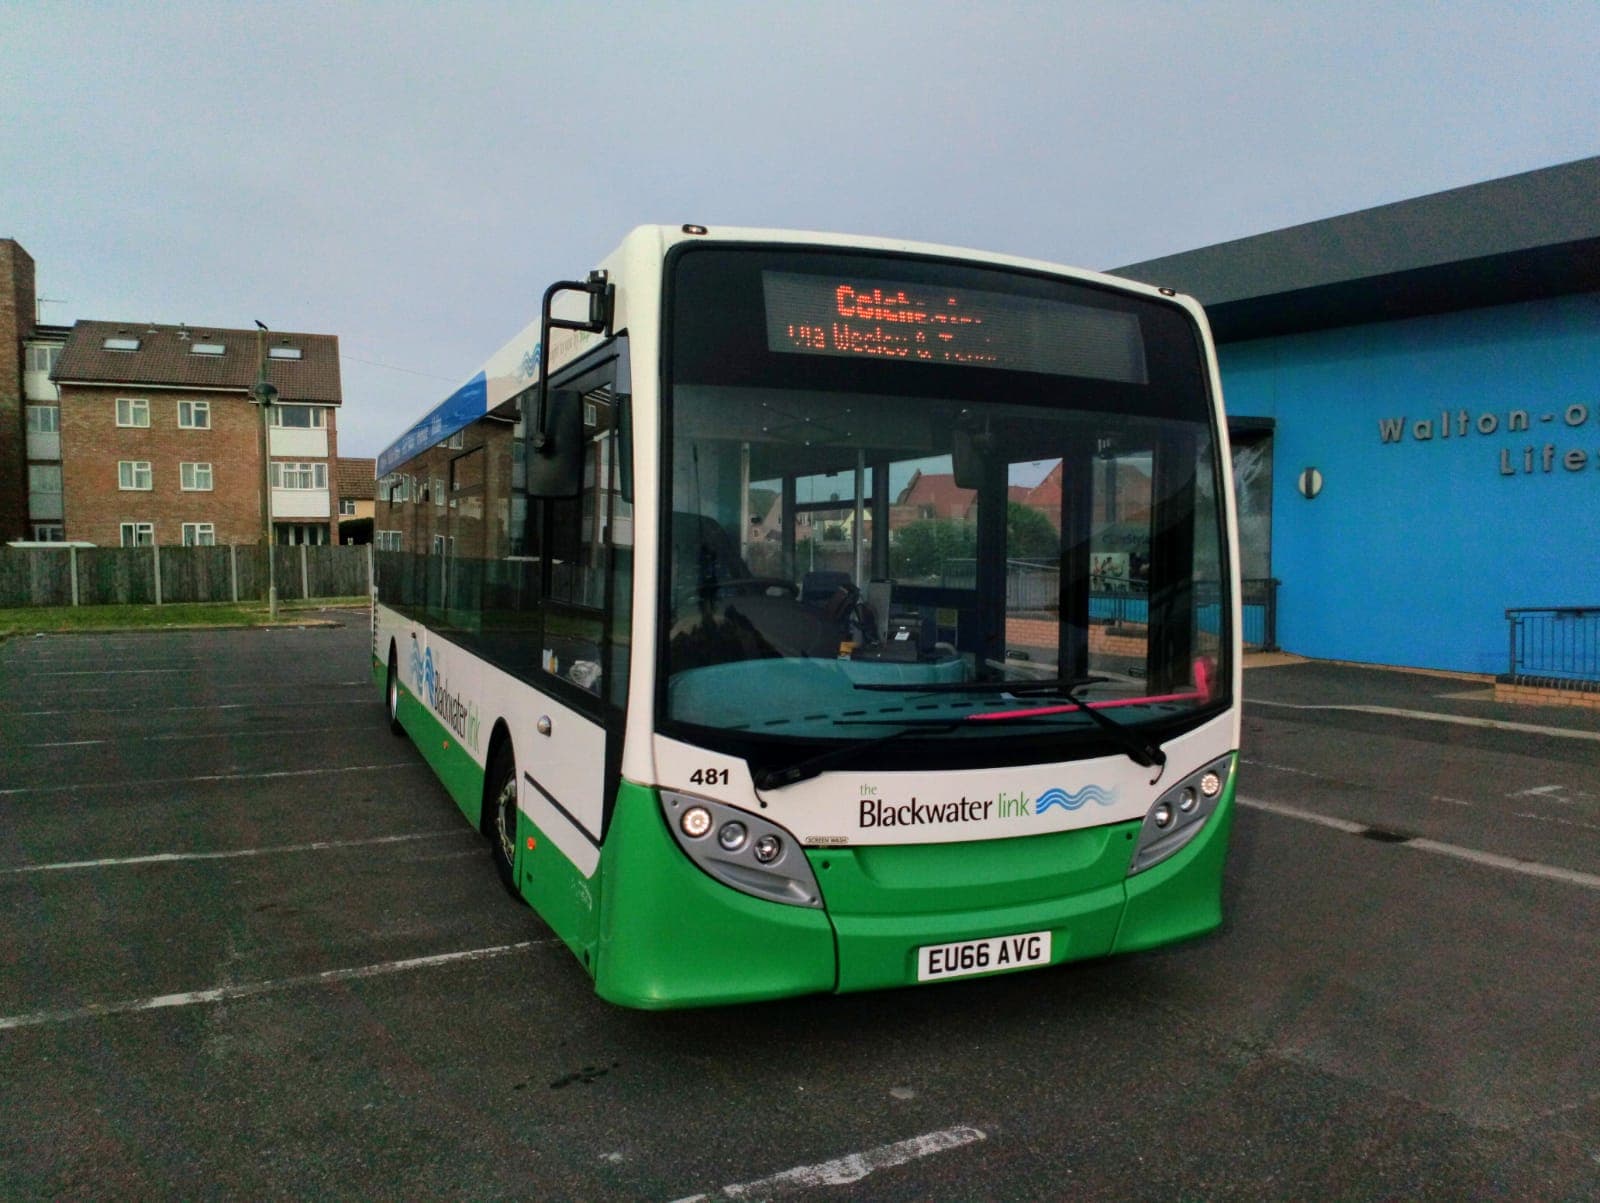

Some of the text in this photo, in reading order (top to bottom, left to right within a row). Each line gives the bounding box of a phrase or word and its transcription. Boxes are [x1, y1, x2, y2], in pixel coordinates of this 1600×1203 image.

[1379, 403, 1600, 444] Walton-o
[1500, 443, 1600, 476] Life
[689, 768, 729, 785] 481
[859, 784, 877, 796] the
[859, 791, 1031, 828] Blackwater link
[928, 936, 1041, 974] EU66 AVG
